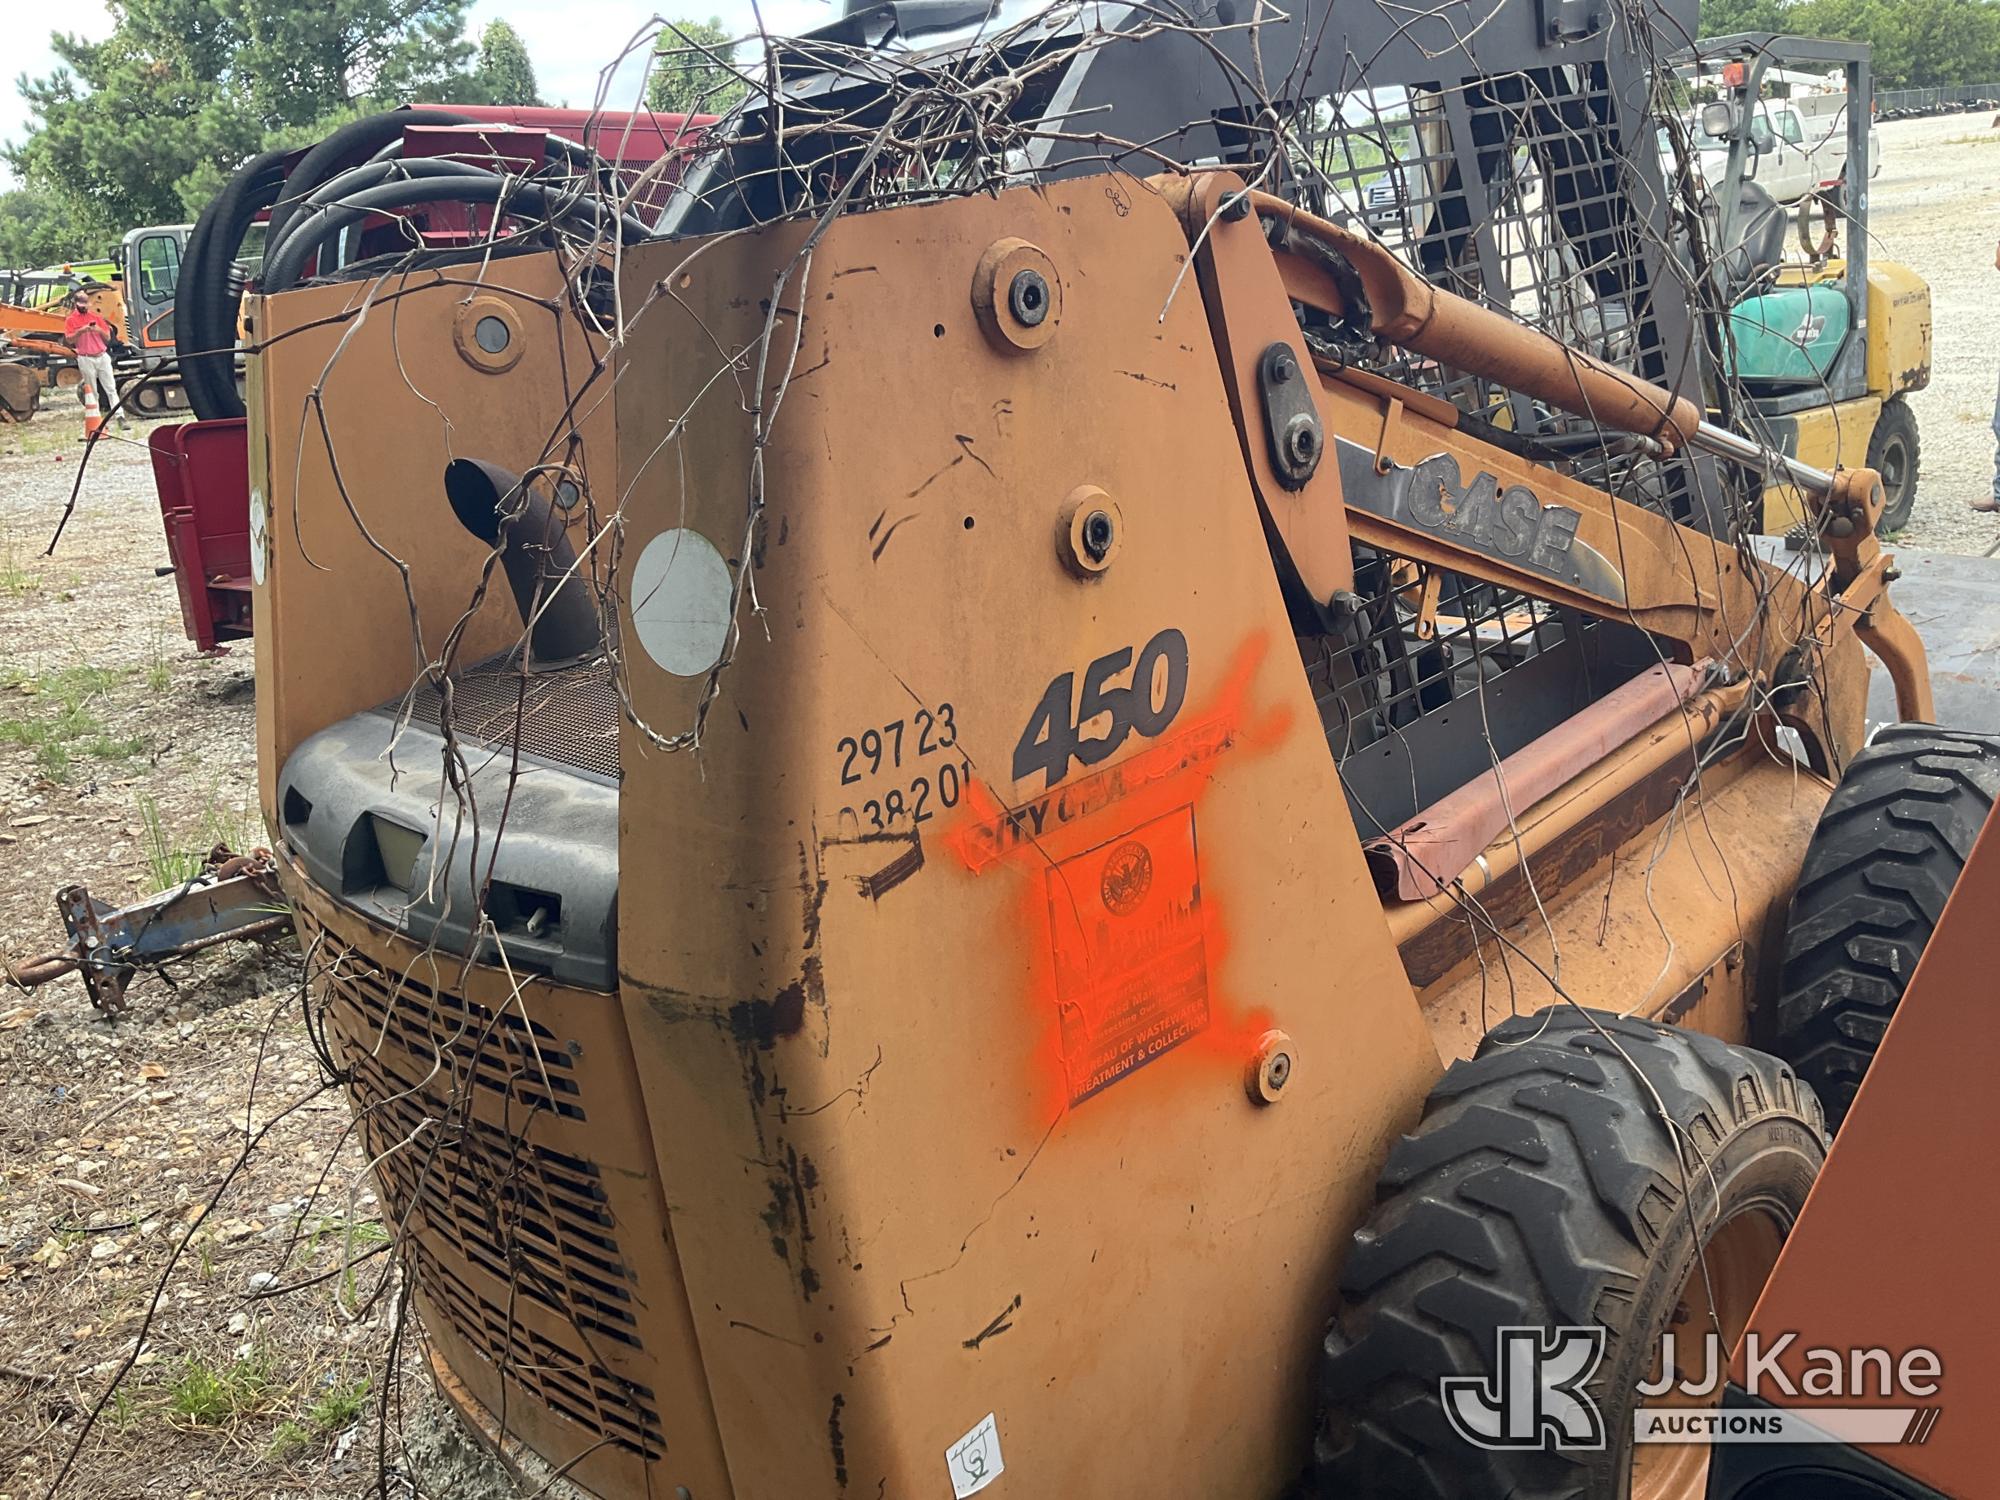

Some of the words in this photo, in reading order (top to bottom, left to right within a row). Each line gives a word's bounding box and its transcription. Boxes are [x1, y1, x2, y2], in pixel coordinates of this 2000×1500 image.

[1408, 451, 1583, 573] CASE
[1013, 628, 1189, 788] 450
[1073, 1053, 1135, 1099] TREATMENT
[1137, 1048, 1146, 1061] &
[1148, 1010, 1208, 1055] COLLECTION
[1119, 1037, 1135, 1054] OF
[1136, 997, 1205, 1045] WASTEWATER
